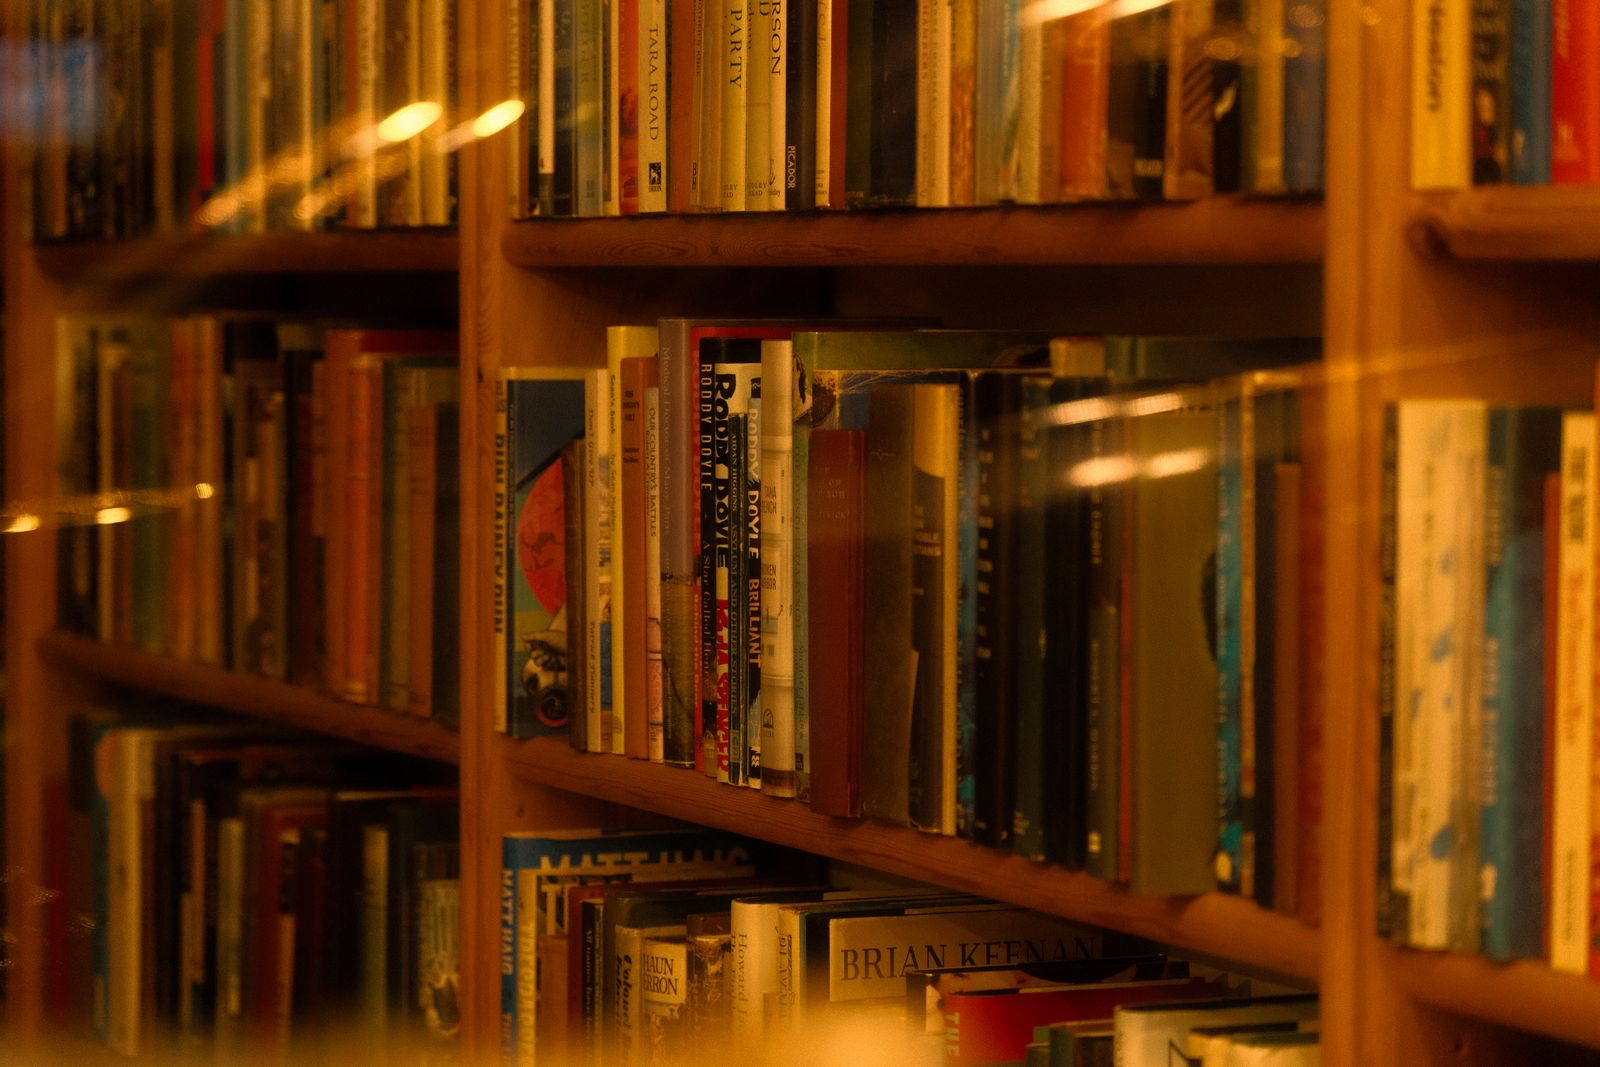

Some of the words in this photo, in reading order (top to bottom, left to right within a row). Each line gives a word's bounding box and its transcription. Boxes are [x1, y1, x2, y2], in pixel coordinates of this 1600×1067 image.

[648, 24, 659, 75] TARA
[730, 8, 743, 88] PARTY
[648, 83, 659, 141] ROAD
[787, 145, 796, 189] PICADOR
[648, 407, 656, 430] OUR
[701, 363, 713, 424] RODDY
[648, 433, 658, 490] COUNTRY'S
[701, 434, 713, 491] DOYLE
[748, 408, 760, 479] RODDY
[648, 494, 657, 538] BATTLES
[748, 490, 760, 560] DOYLE
[749, 578, 761, 668] BRILLIANT
[501, 868, 514, 926] MATT
[642, 957, 676, 976] HAUN
[642, 977, 679, 996] ERRON
[737, 932, 750, 1003] Howard
[839, 943, 947, 982] BRIAN
[958, 935, 1097, 967] KEENAN
